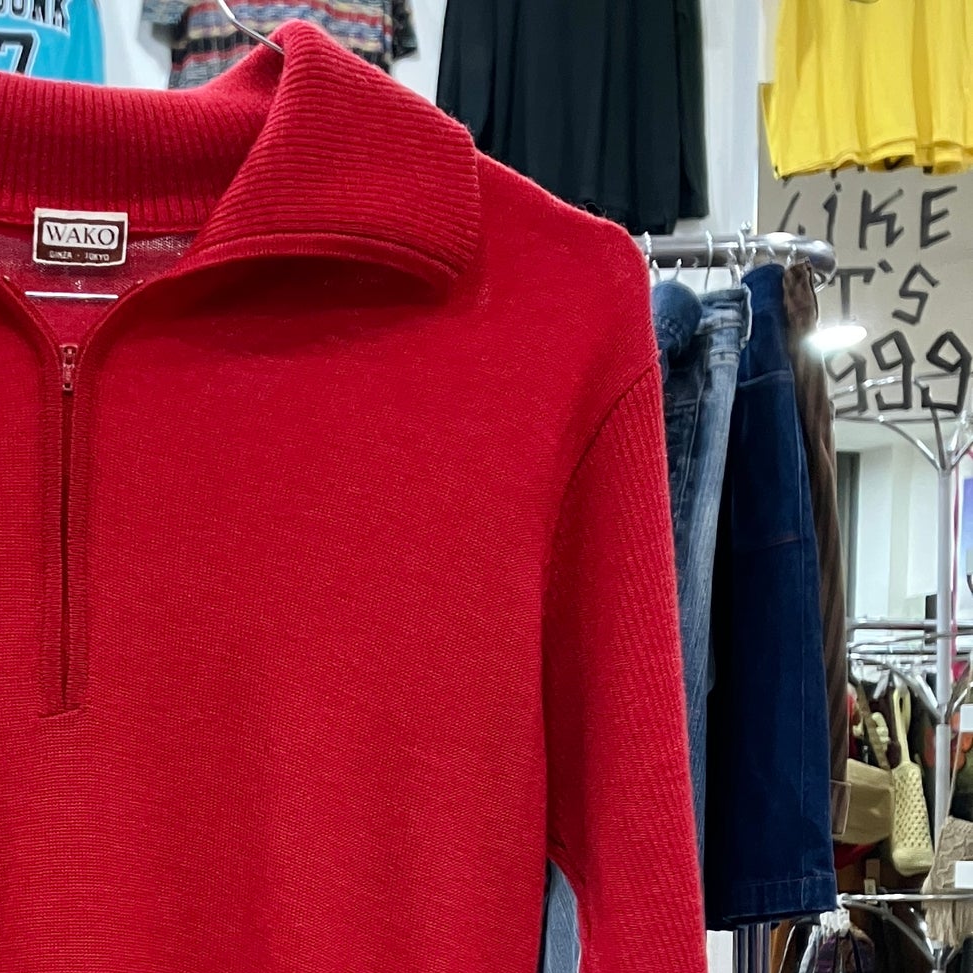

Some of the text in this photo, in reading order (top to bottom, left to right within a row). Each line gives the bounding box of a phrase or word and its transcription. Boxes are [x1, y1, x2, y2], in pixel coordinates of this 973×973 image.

[45, 224, 116, 247] WAKO
[48, 250, 110, 262] GINZA TOKYO
[828, 260, 941, 326] T'S
[824, 329, 972, 416] 999
